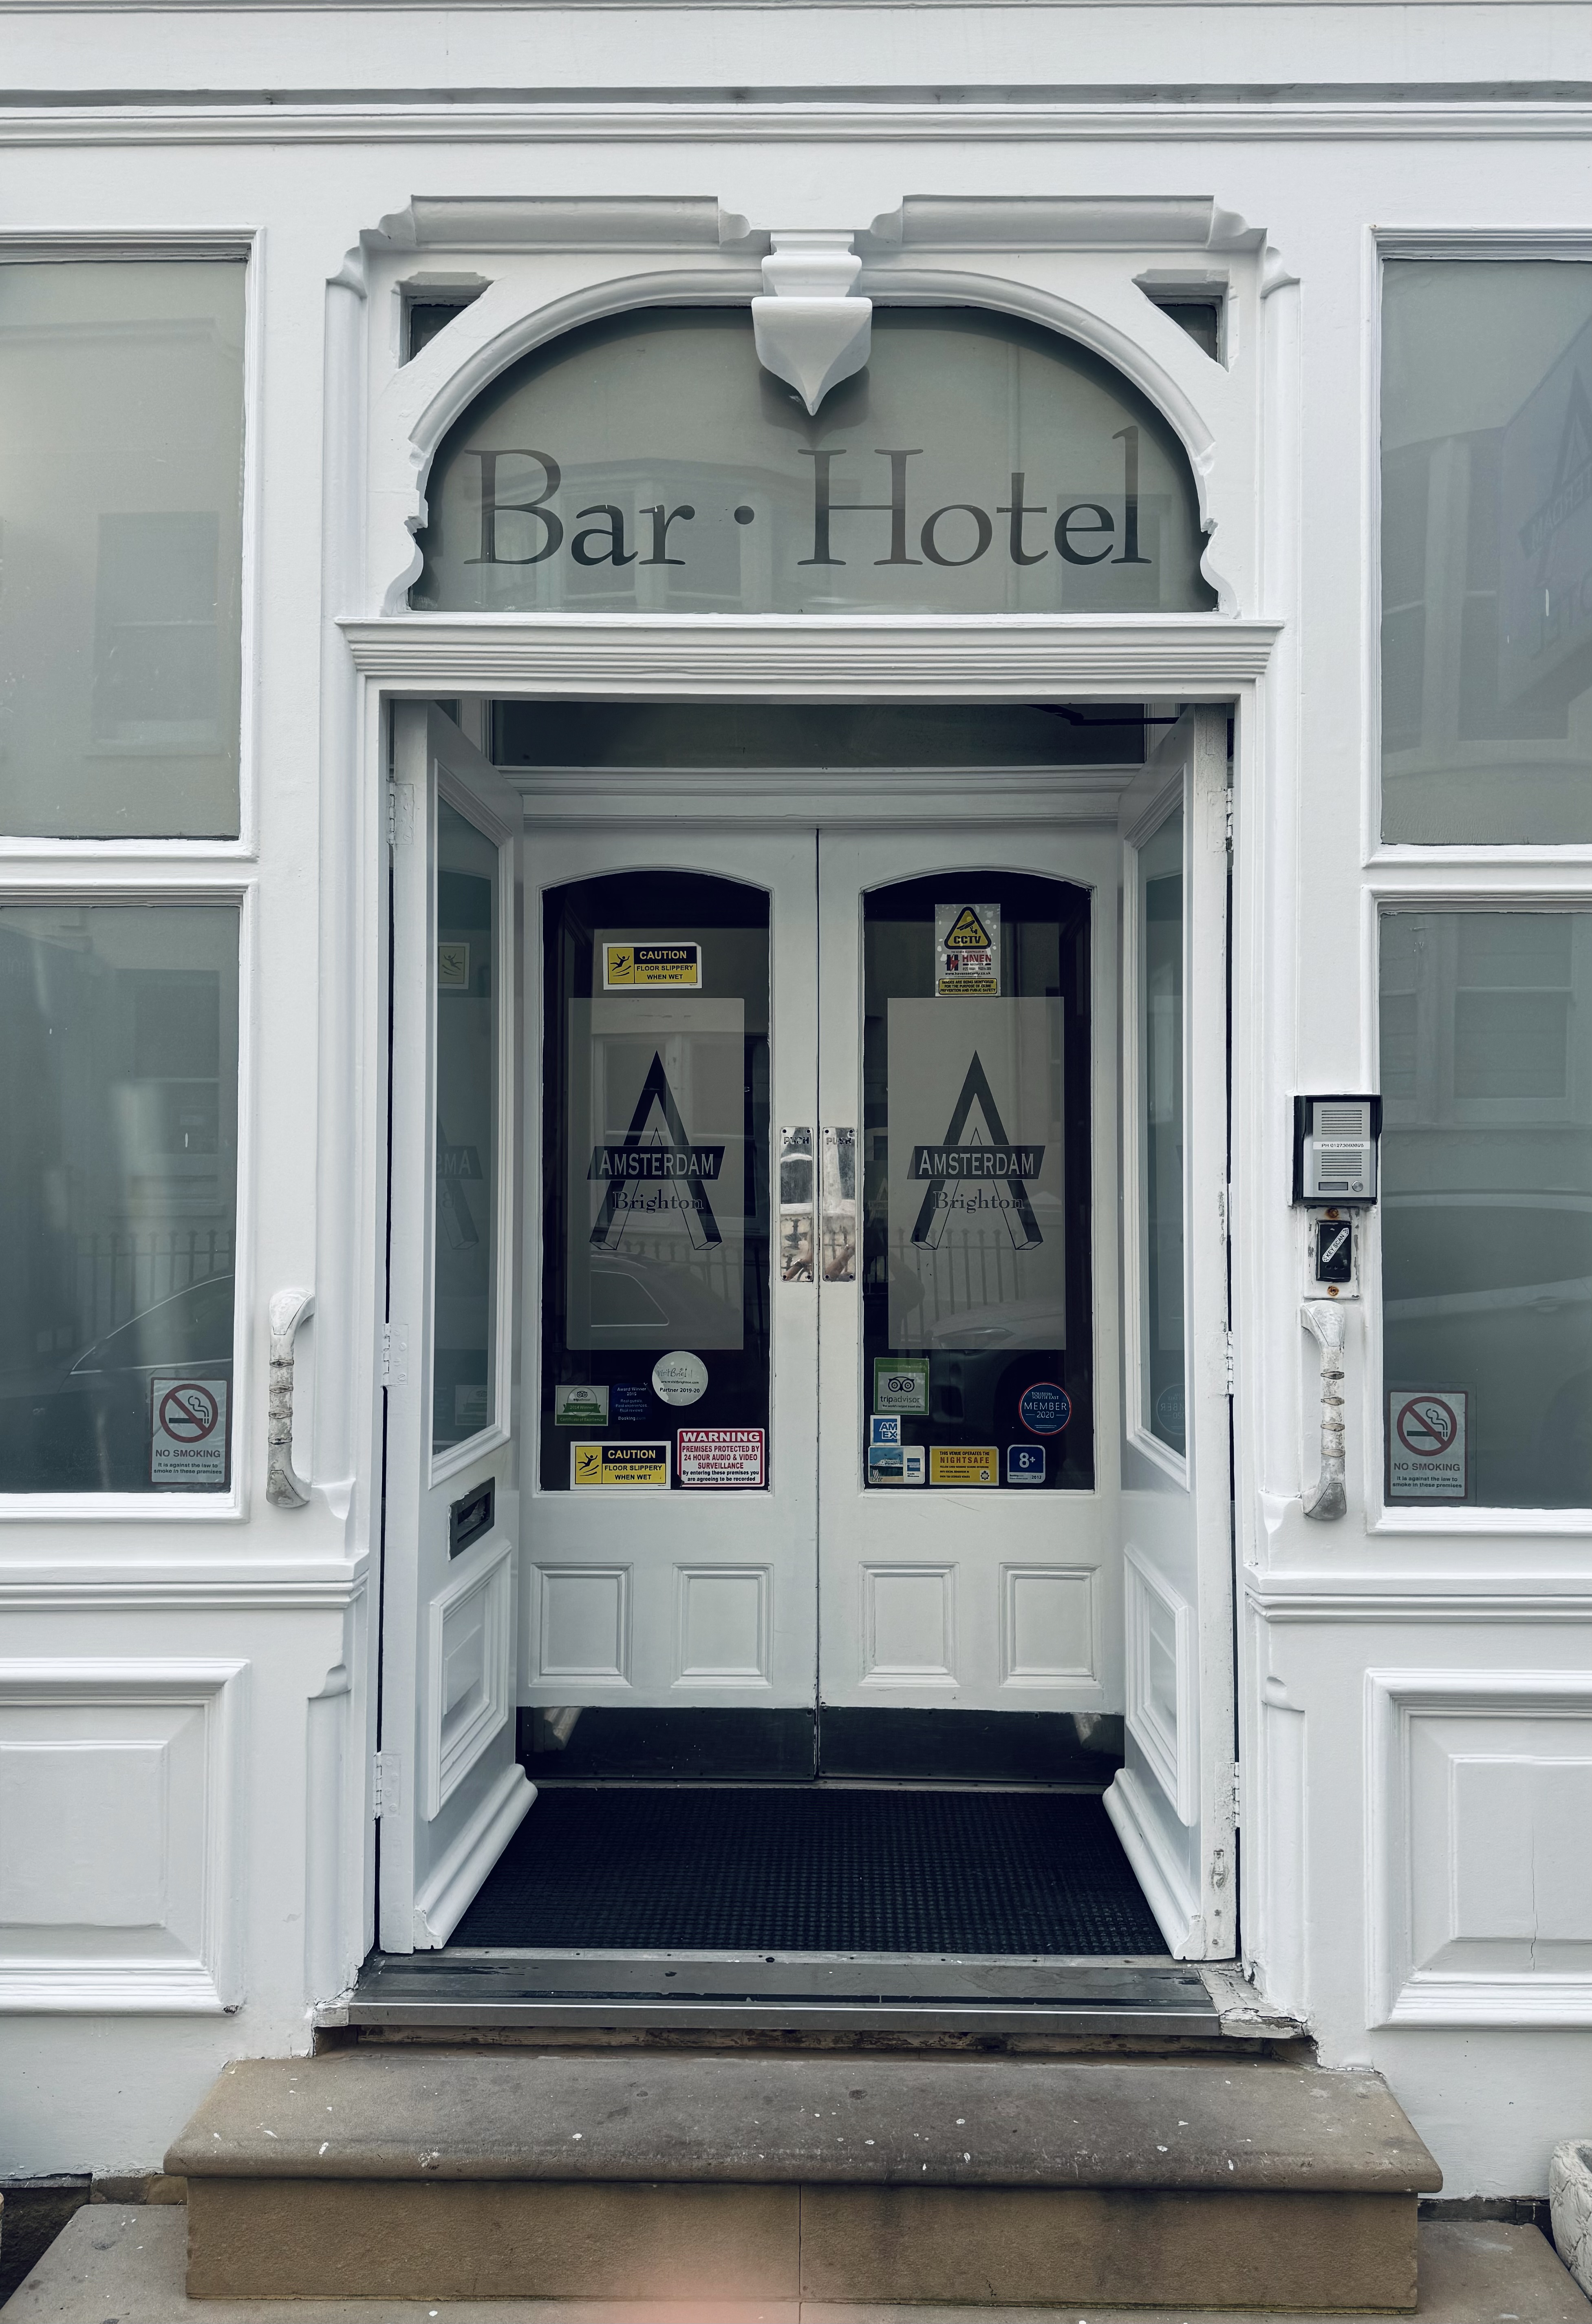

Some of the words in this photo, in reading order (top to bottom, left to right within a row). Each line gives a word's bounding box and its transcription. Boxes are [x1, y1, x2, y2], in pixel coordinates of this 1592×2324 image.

[464, 448, 695, 567] Bar
[797, 426, 1152, 567] Hotel
[954, 936, 981, 944] CCTV
[639, 951, 687, 959] CAUTION
[962, 954, 992, 962] HAVEN
[599, 1150, 714, 1175] AMSTERDAM
[918, 1150, 1034, 1175] AMSTERDAM
[613, 1189, 704, 1214] Brighton
[933, 1189, 1025, 1214] Brighton
[1326, 1247, 1334, 1258] KEY
[1333, 1234, 1345, 1248] SCAN
[880, 1395, 920, 1404] tripadvisor
[1024, 1401, 1067, 1410] MEMBER
[682, 1432, 760, 1442] WARNING
[173, 1450, 221, 1458] SMOKING
[608, 1450, 656, 1459] CAUTION
[1019, 1452, 1036, 1468] 8+
[1412, 1463, 1460, 1471] SMOKING
